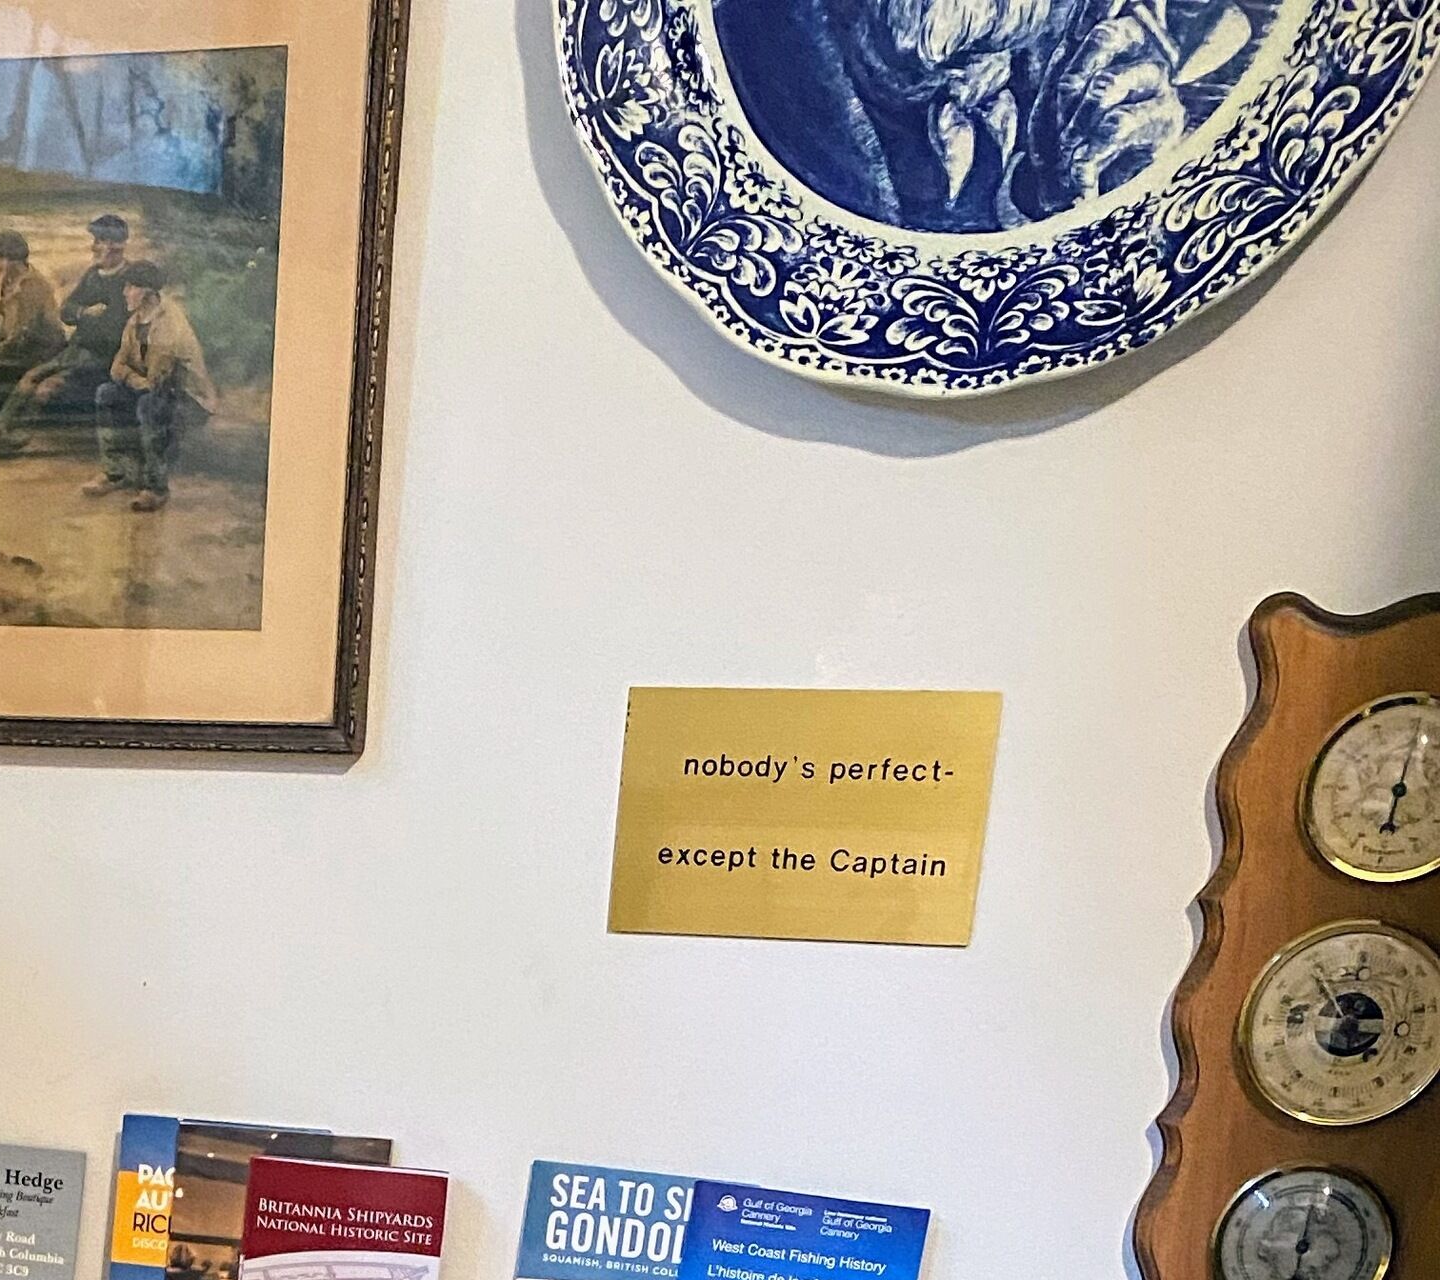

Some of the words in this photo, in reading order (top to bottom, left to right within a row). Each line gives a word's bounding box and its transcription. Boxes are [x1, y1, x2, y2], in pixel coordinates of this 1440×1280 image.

[683, 753, 815, 784] nobody's
[829, 758, 954, 785] perfect-
[658, 846, 757, 872] except
[771, 848, 816, 871] the
[829, 849, 947, 879] Captain
[5, 1168, 64, 1194] Hedge
[550, 1174, 606, 1211] SEA
[618, 1180, 655, 1217] TO
[259, 1197, 342, 1220] BRITANNIA
[348, 1207, 434, 1229] SHIPYARDS
[741, 1209, 781, 1223] Cannery
[743, 1198, 762, 1209] Gulf
[764, 1201, 775, 1210] of
[776, 1203, 813, 1217] Georgia
[257, 1215, 325, 1235] NATIONAL
[331, 1223, 399, 1242] HISTORIC
[403, 1230, 432, 1246] SITE
[819, 1227, 860, 1241] Cannery
[822, 1216, 842, 1226] Gulf
[844, 1218, 854, 1227] of
[855, 1221, 893, 1233] Georgia
[6, 1231, 35, 1245] Road
[9, 1249, 64, 1265] Columbia
[606, 1261, 649, 1274] BRITISH
[712, 1239, 745, 1254] West
[748, 1244, 786, 1261] Coast
[789, 1249, 836, 1269] Fishing
[839, 1256, 887, 1276] History
